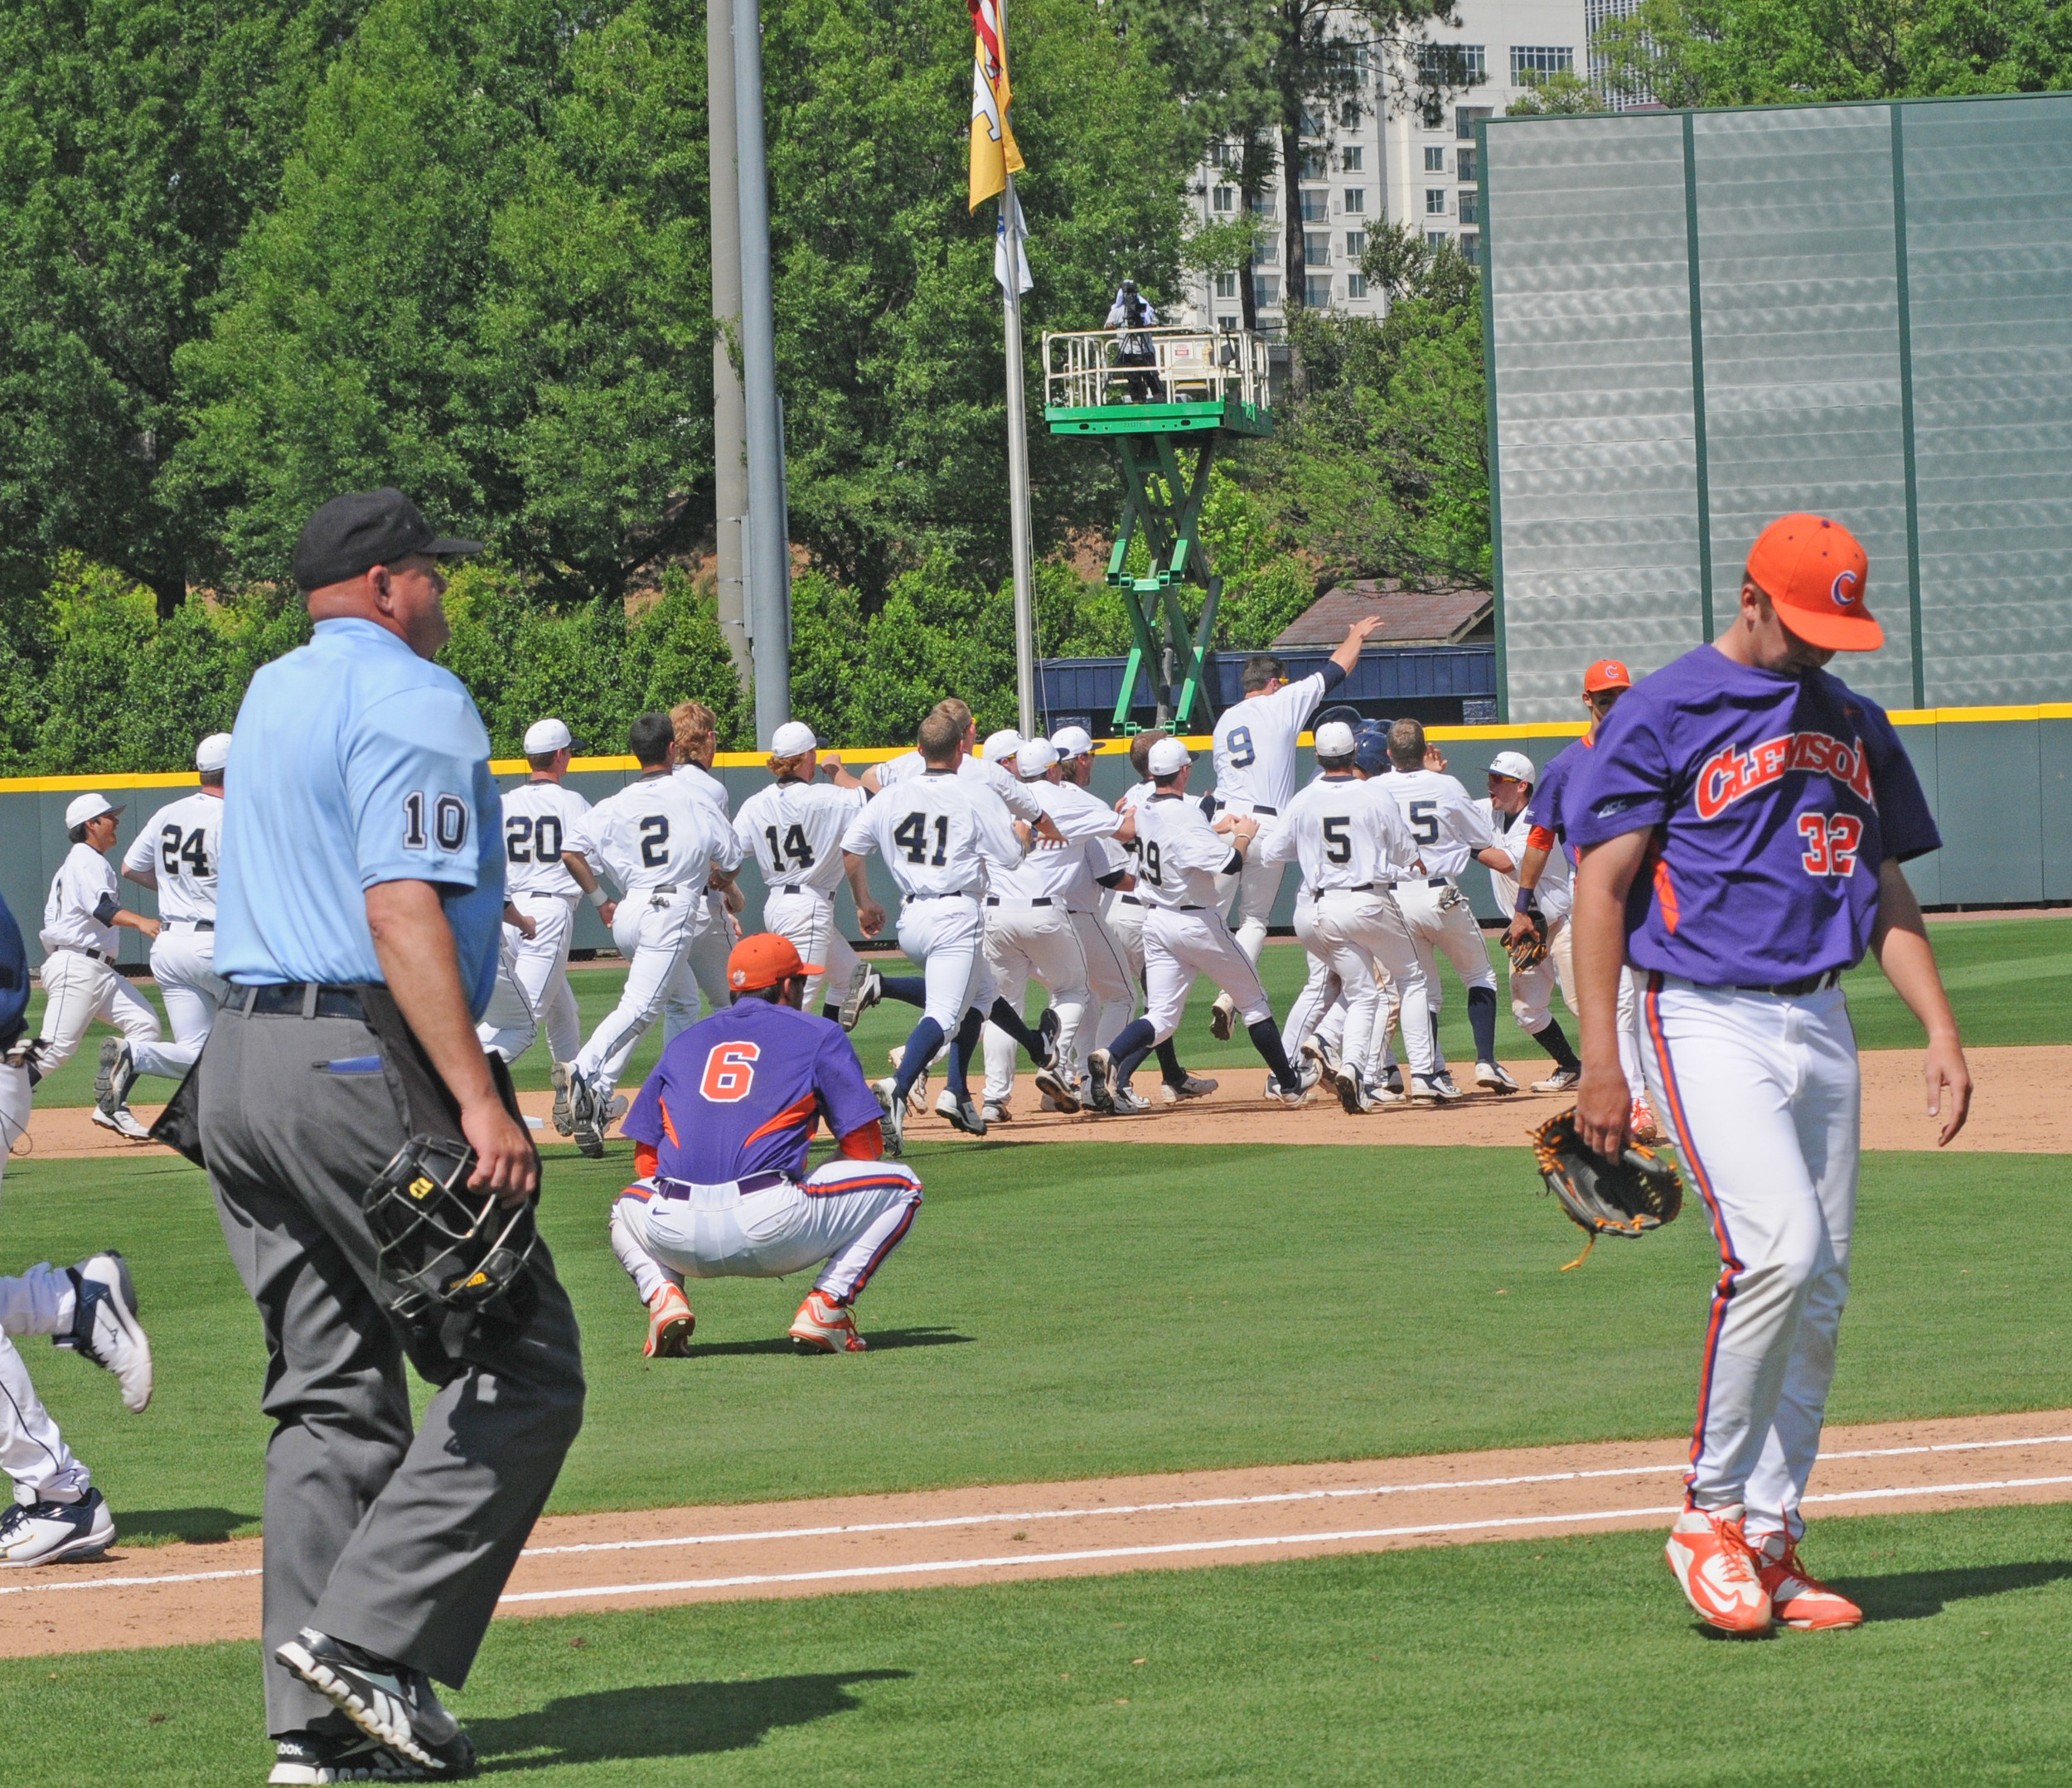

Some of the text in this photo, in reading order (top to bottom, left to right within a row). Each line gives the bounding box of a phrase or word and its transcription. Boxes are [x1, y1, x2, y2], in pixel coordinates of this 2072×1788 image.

[1831, 569, 1857, 607] C
[1605, 665, 1619, 678] C
[1226, 724, 1256, 770] 9
[403, 791, 470, 855] 10
[506, 815, 564, 864] 20
[639, 814, 670, 869] 2
[765, 823, 816, 873] 14
[893, 811, 950, 867] 41
[1323, 816, 1352, 864] 5
[1797, 812, 1864, 878] 32
[161, 823, 211, 877] 24
[699, 1040, 762, 1103] 6
